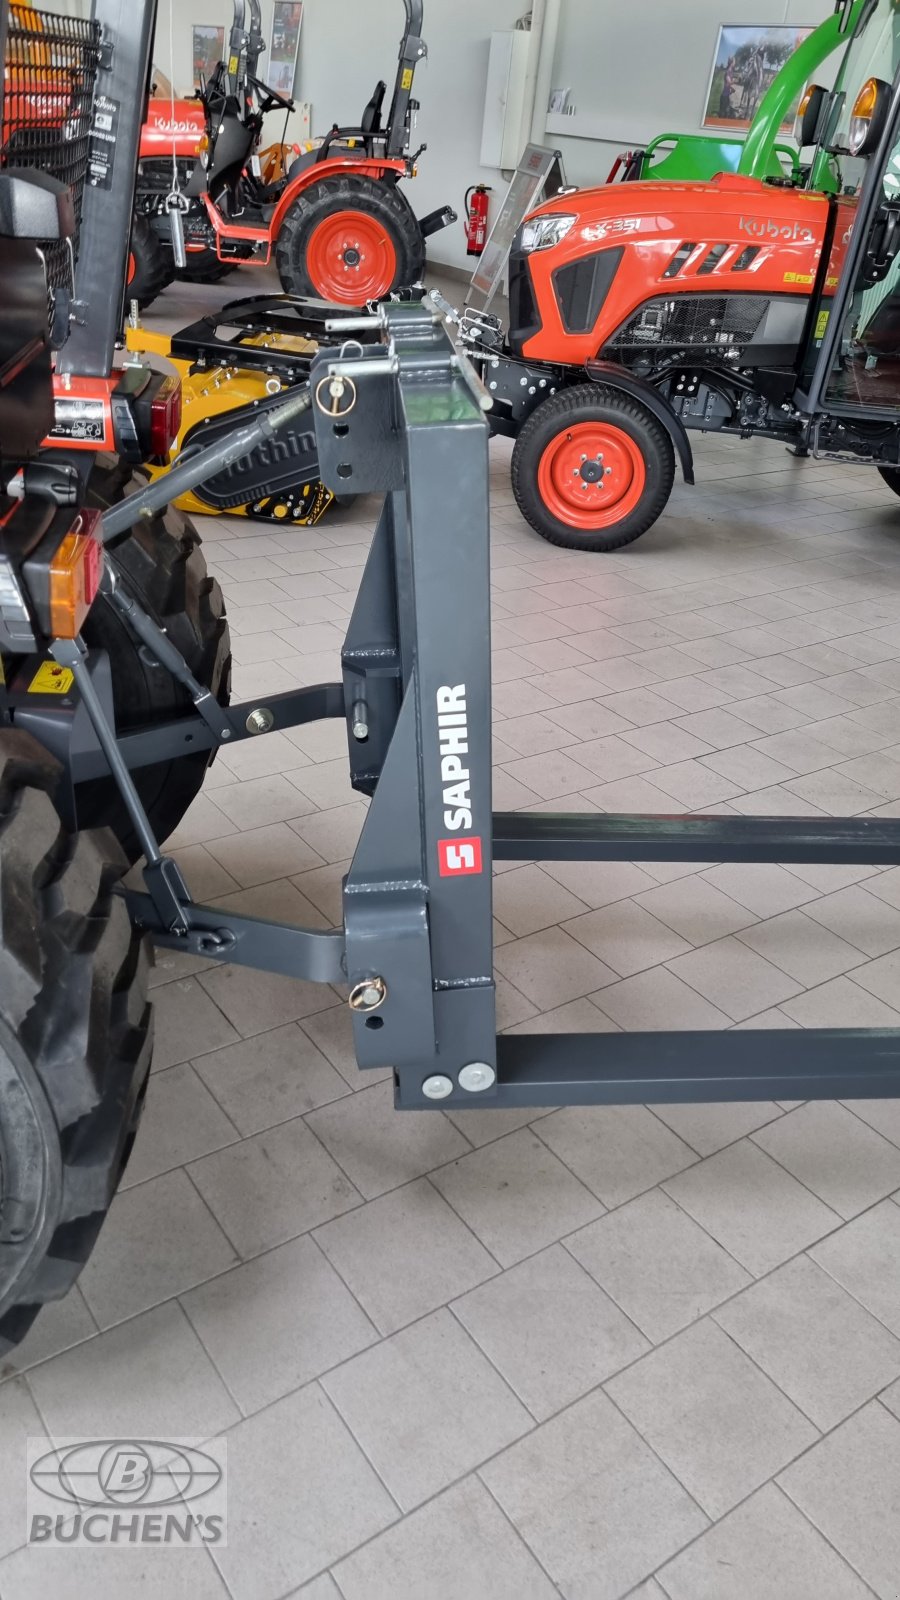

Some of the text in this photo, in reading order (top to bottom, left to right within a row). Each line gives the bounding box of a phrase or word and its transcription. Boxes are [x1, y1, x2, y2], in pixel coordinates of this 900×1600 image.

[155, 117, 198, 131] Kubota
[739, 217, 812, 240] Kubota
[437, 684, 472, 831] SAPHIR
